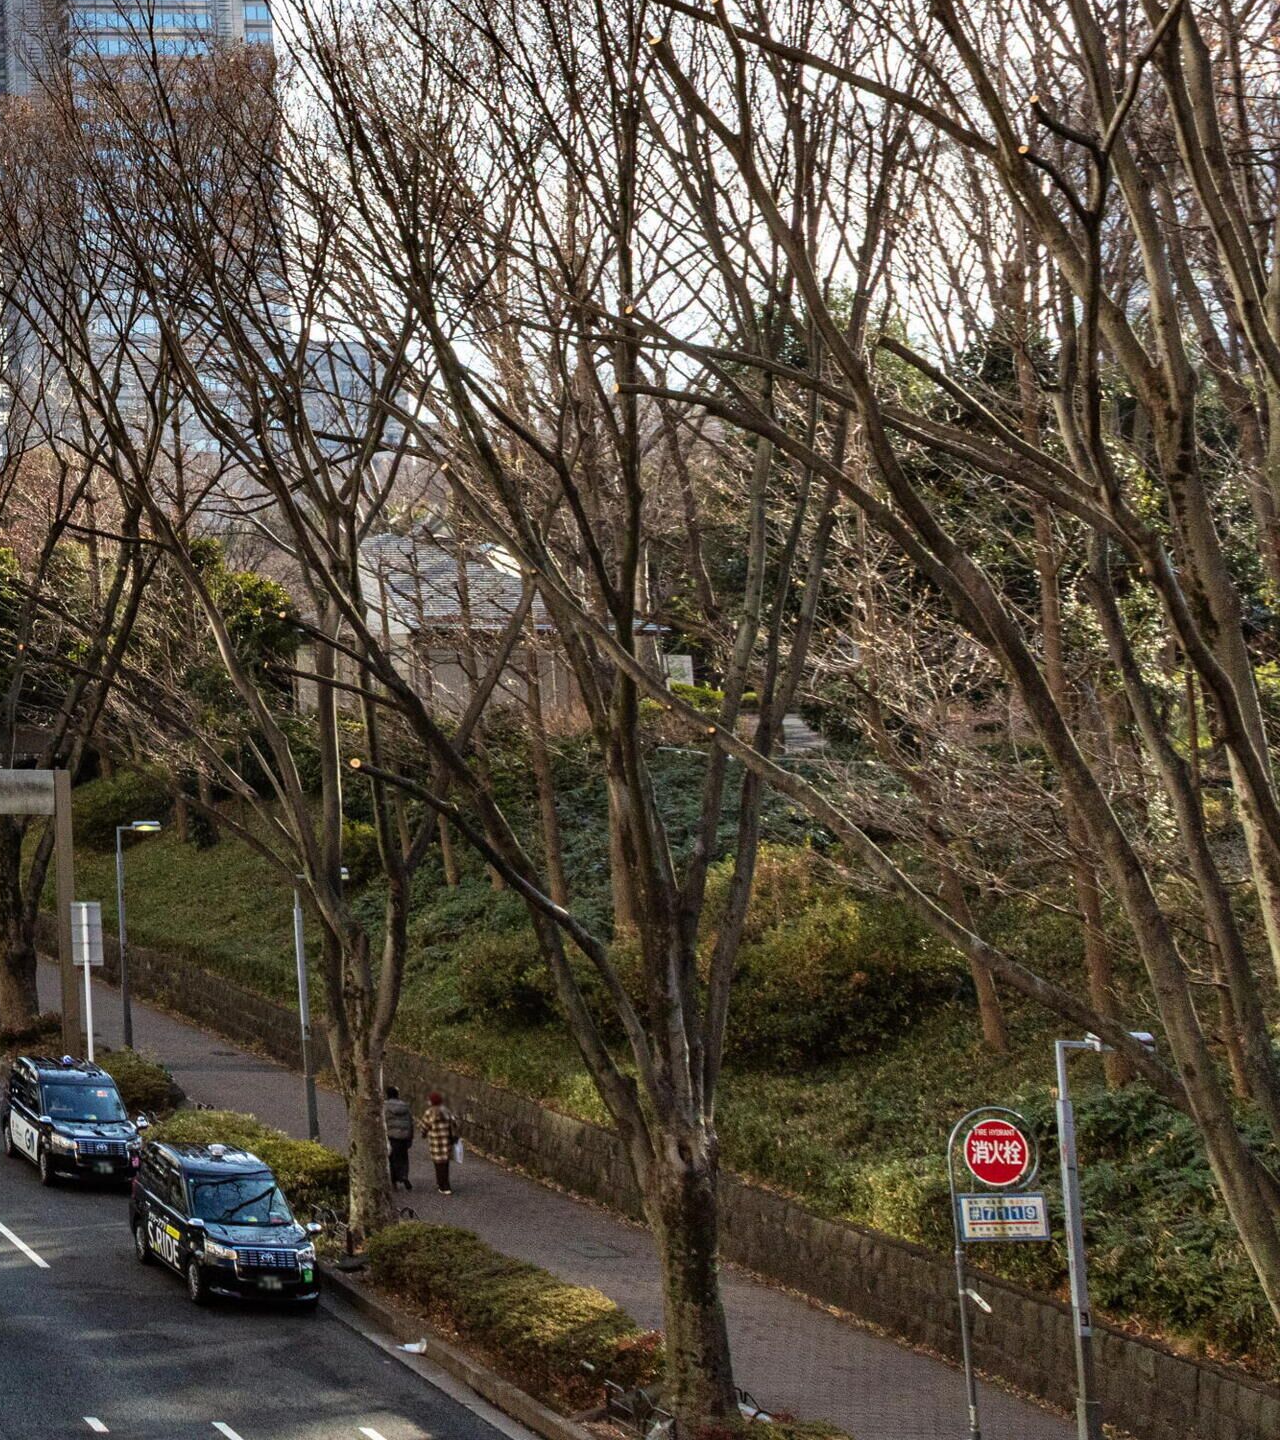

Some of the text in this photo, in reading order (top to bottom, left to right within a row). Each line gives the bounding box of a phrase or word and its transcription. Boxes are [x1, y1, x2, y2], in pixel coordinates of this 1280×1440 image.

[975, 1128, 1015, 1137] FIRE HYDRANT
[971, 1140, 1023, 1164] 消火栓
